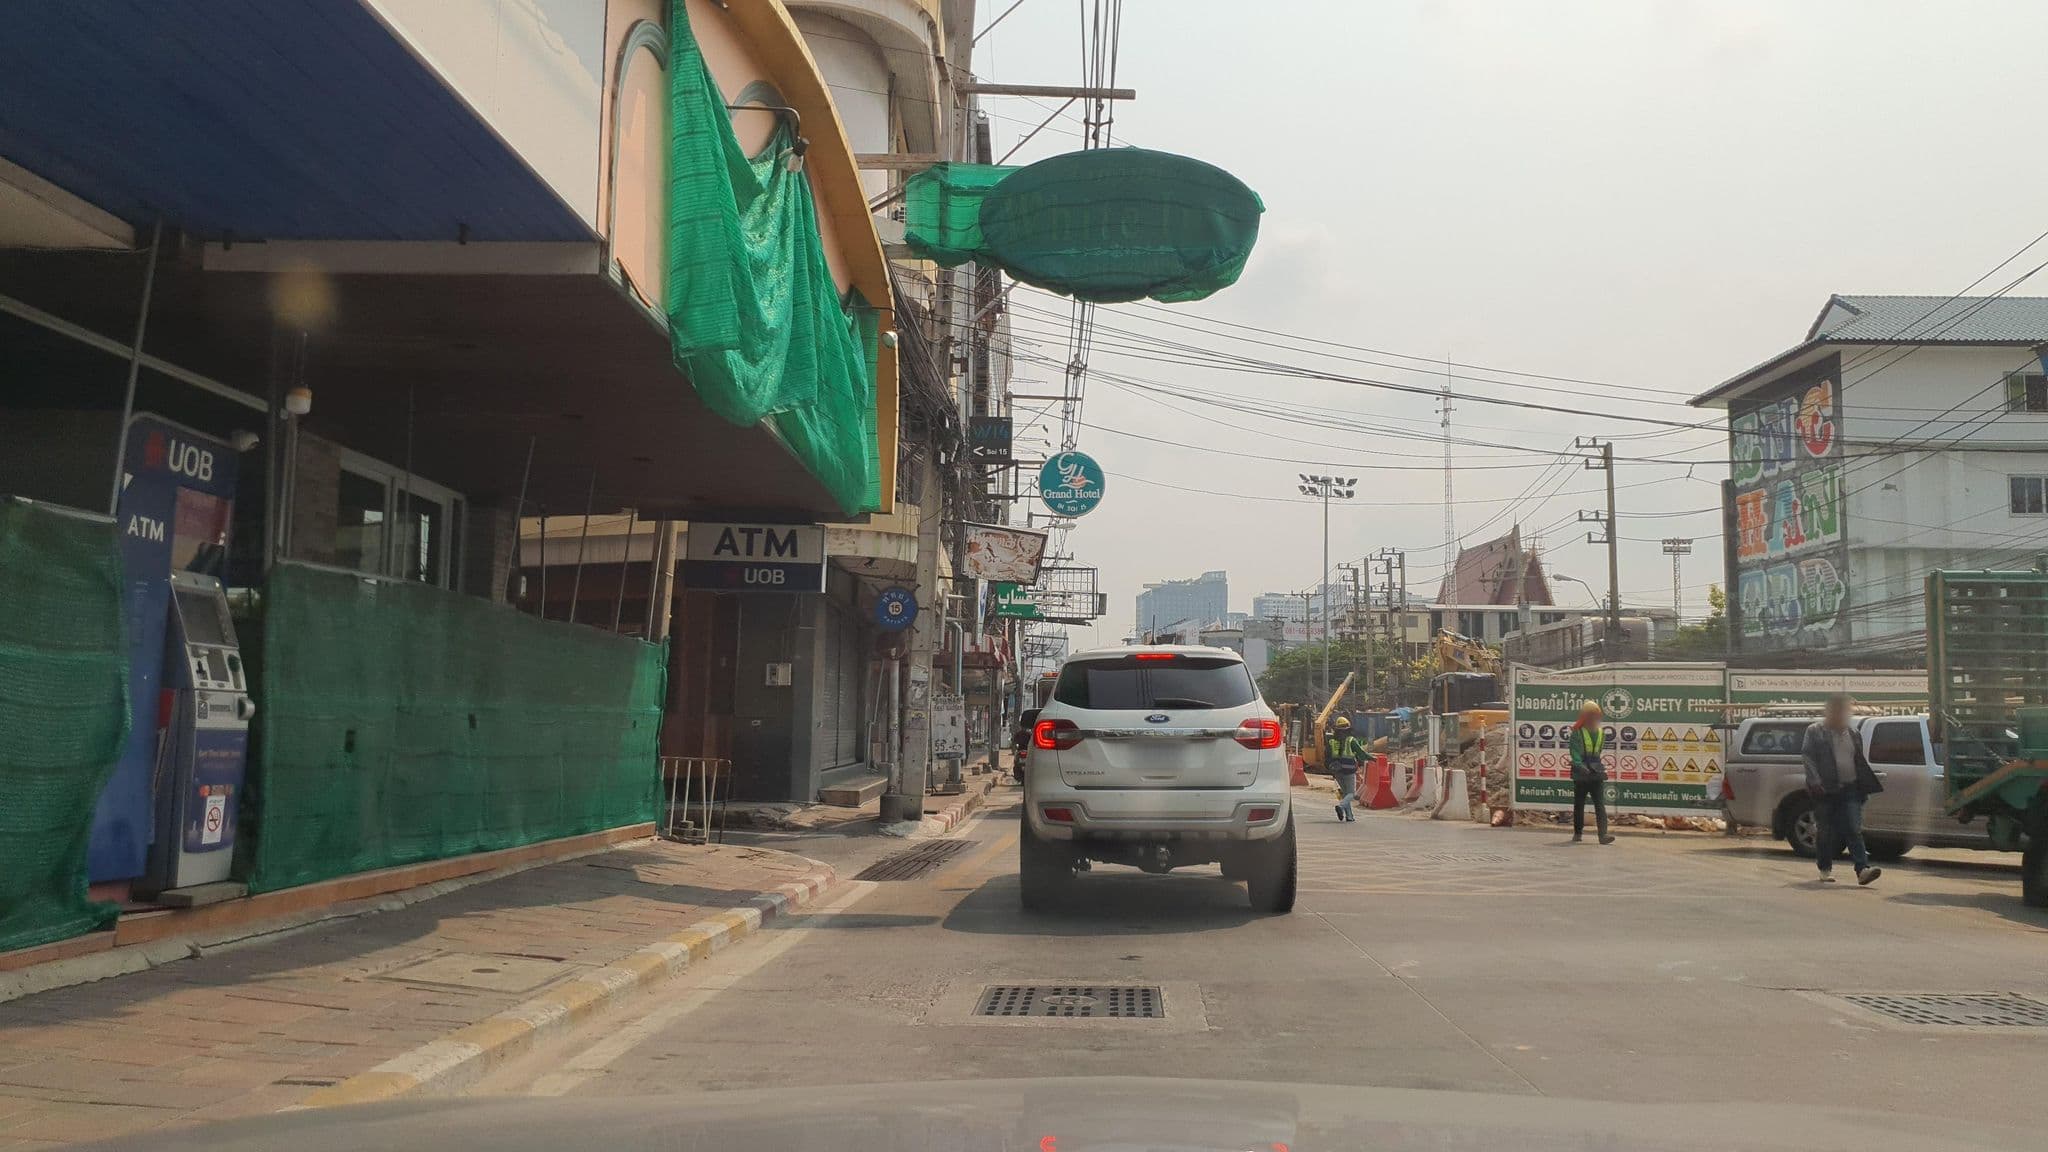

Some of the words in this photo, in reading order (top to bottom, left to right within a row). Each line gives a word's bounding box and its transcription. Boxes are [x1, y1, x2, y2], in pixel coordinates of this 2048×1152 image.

[168, 439, 213, 481] UOB
[1043, 489, 1072, 499] Grand
[1074, 489, 1100, 499] Hotel
[127, 514, 164, 543] ATM
[713, 526, 799, 558] ATM
[744, 568, 786, 585] UOB
[890, 604, 901, 613] 15
[1637, 698, 1682, 712] SAFETY
[1687, 699, 1722, 713] FIRST
